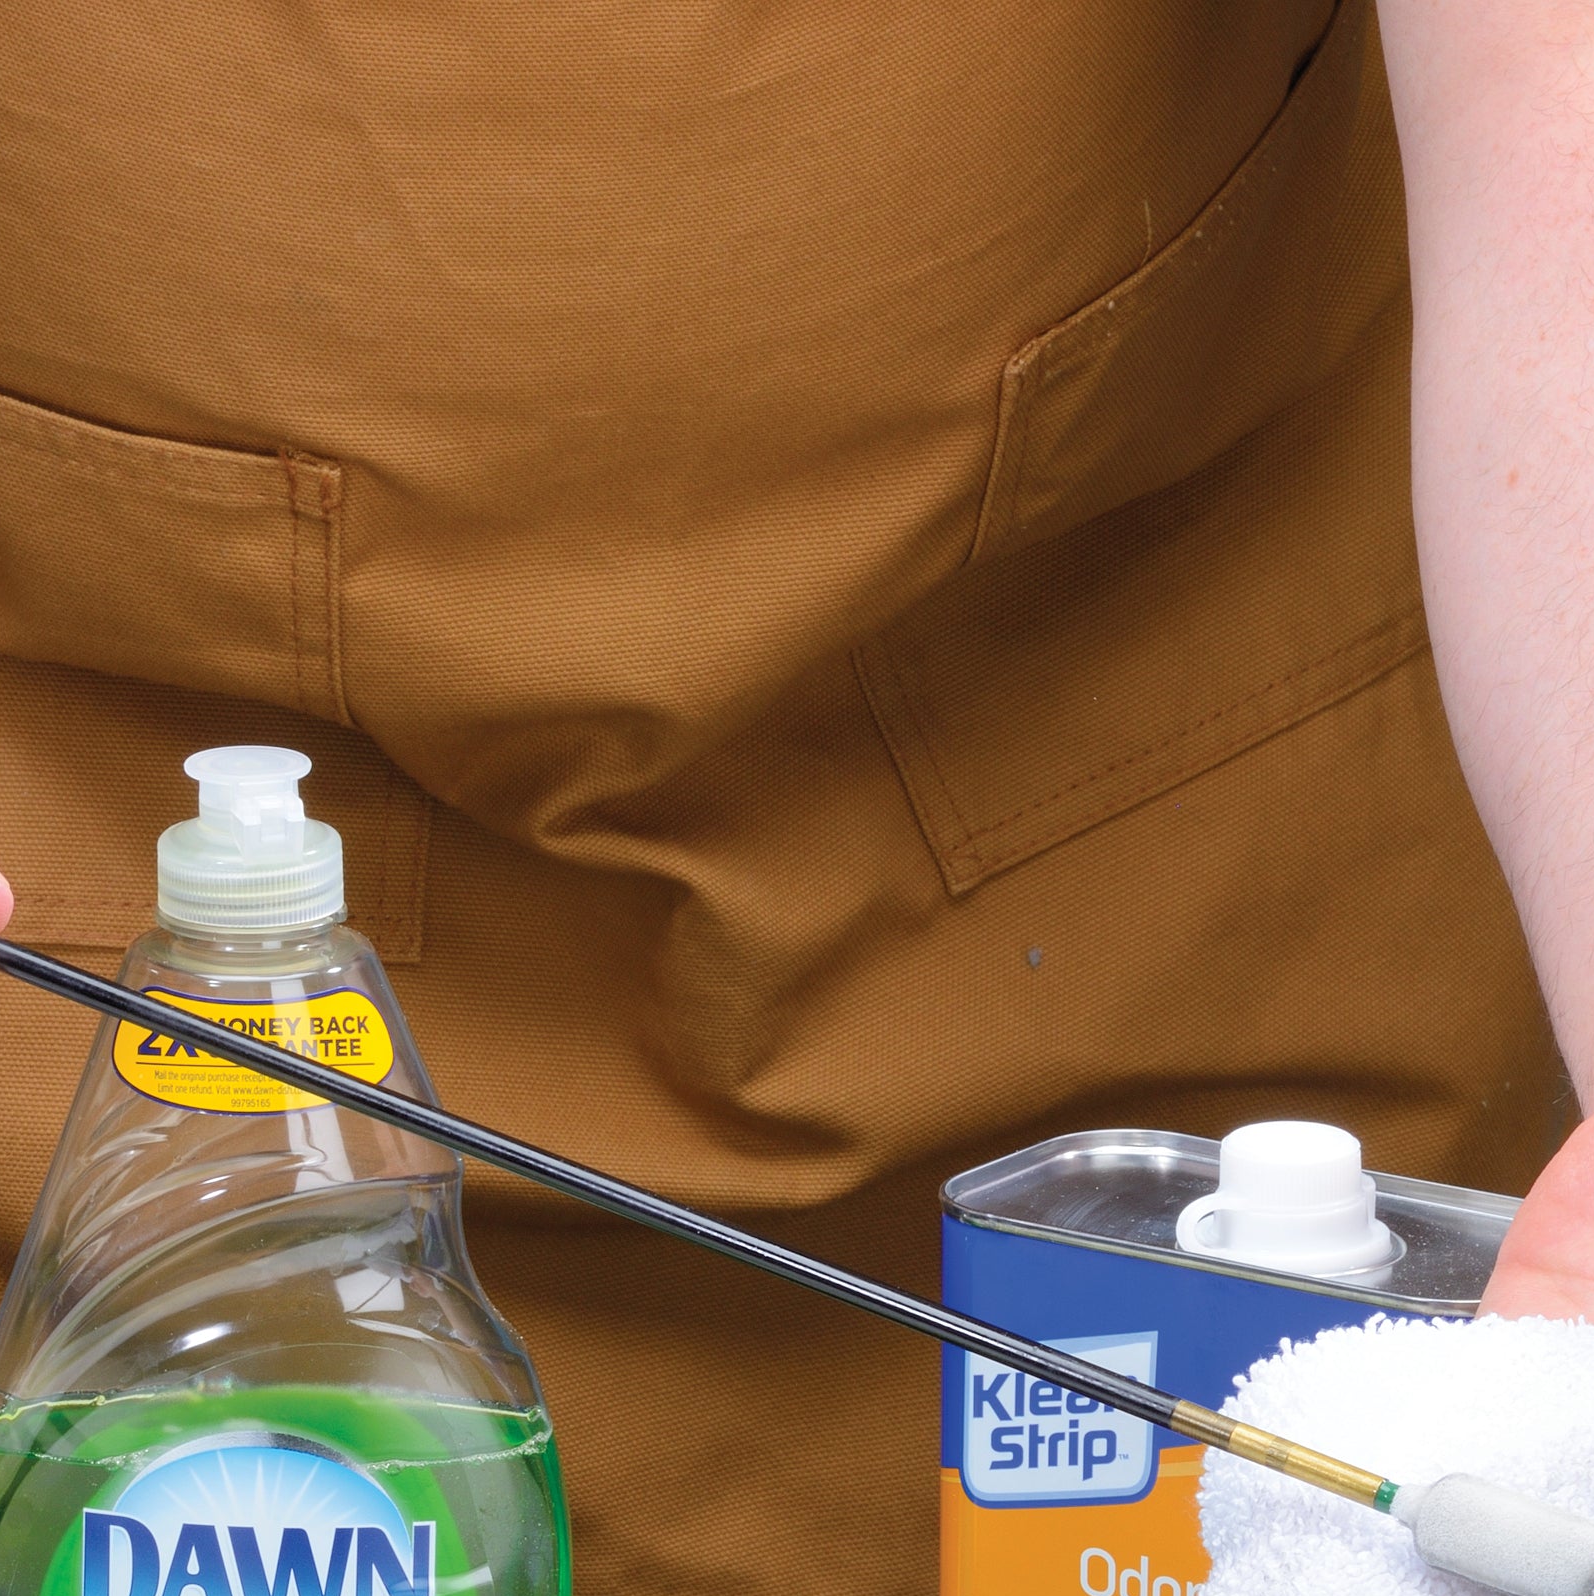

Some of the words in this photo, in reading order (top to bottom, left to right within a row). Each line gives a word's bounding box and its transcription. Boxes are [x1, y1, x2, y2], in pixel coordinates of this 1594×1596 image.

[310, 1015, 370, 1035] BACK
[154, 1069, 167, 1080] Mail
[167, 1070, 179, 1080] the
[180, 1070, 206, 1082] original
[207, 1071, 239, 1083] purchase
[240, 1072, 266, 1083] receipt
[157, 1082, 173, 1093] Limit
[175, 1085, 188, 1094] one
[189, 1084, 214, 1095] refund.
[215, 1086, 231, 1095] Visit
[231, 1098, 271, 1108] 99795165
[973, 1373, 1138, 1421] Klea
